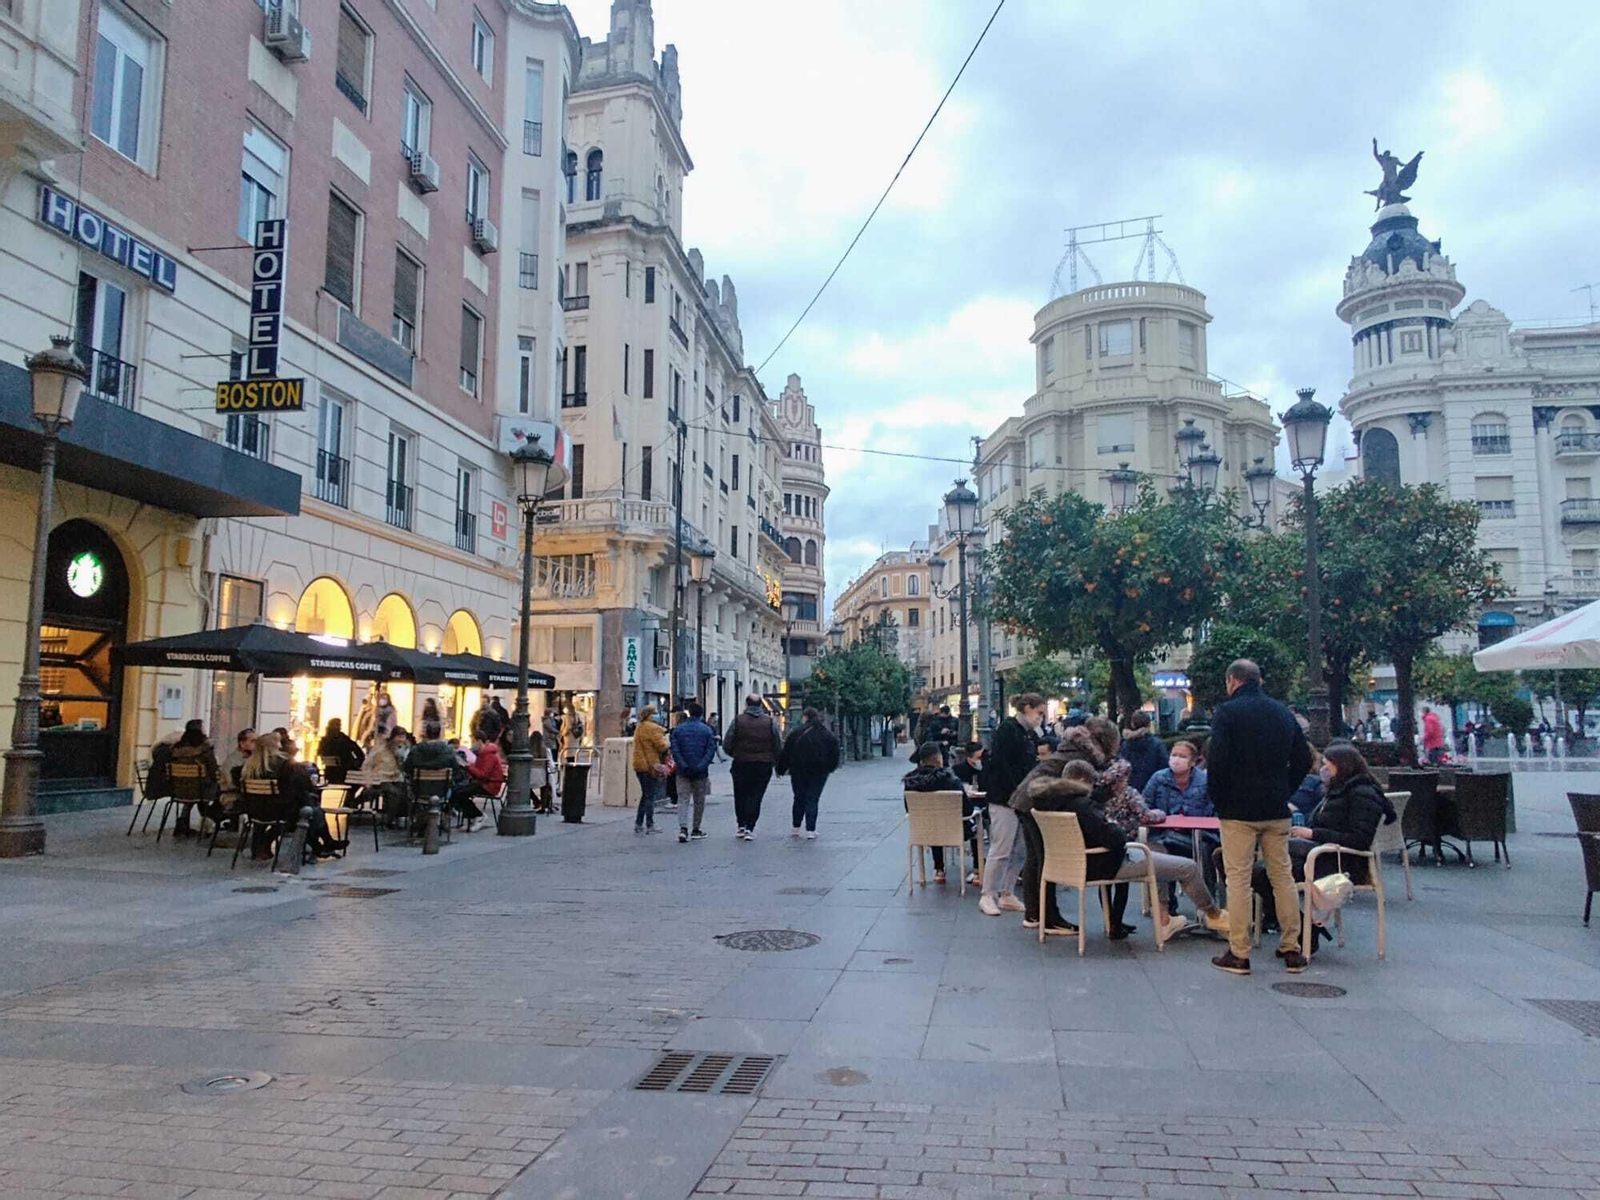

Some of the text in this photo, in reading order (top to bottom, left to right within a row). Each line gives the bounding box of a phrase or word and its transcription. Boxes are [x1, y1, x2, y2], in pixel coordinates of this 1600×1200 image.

[48, 191, 174, 290] HOTEL
[251, 221, 280, 375] HOTEL
[217, 381, 300, 409] BOSTON
[166, 652, 231, 663] STARBUCKS COFFEE
[310, 659, 382, 671] STARBUCKS COFFEE
[627, 638, 637, 684] FARMACIA
[489, 675, 547, 686] STARBUC OFFEE
